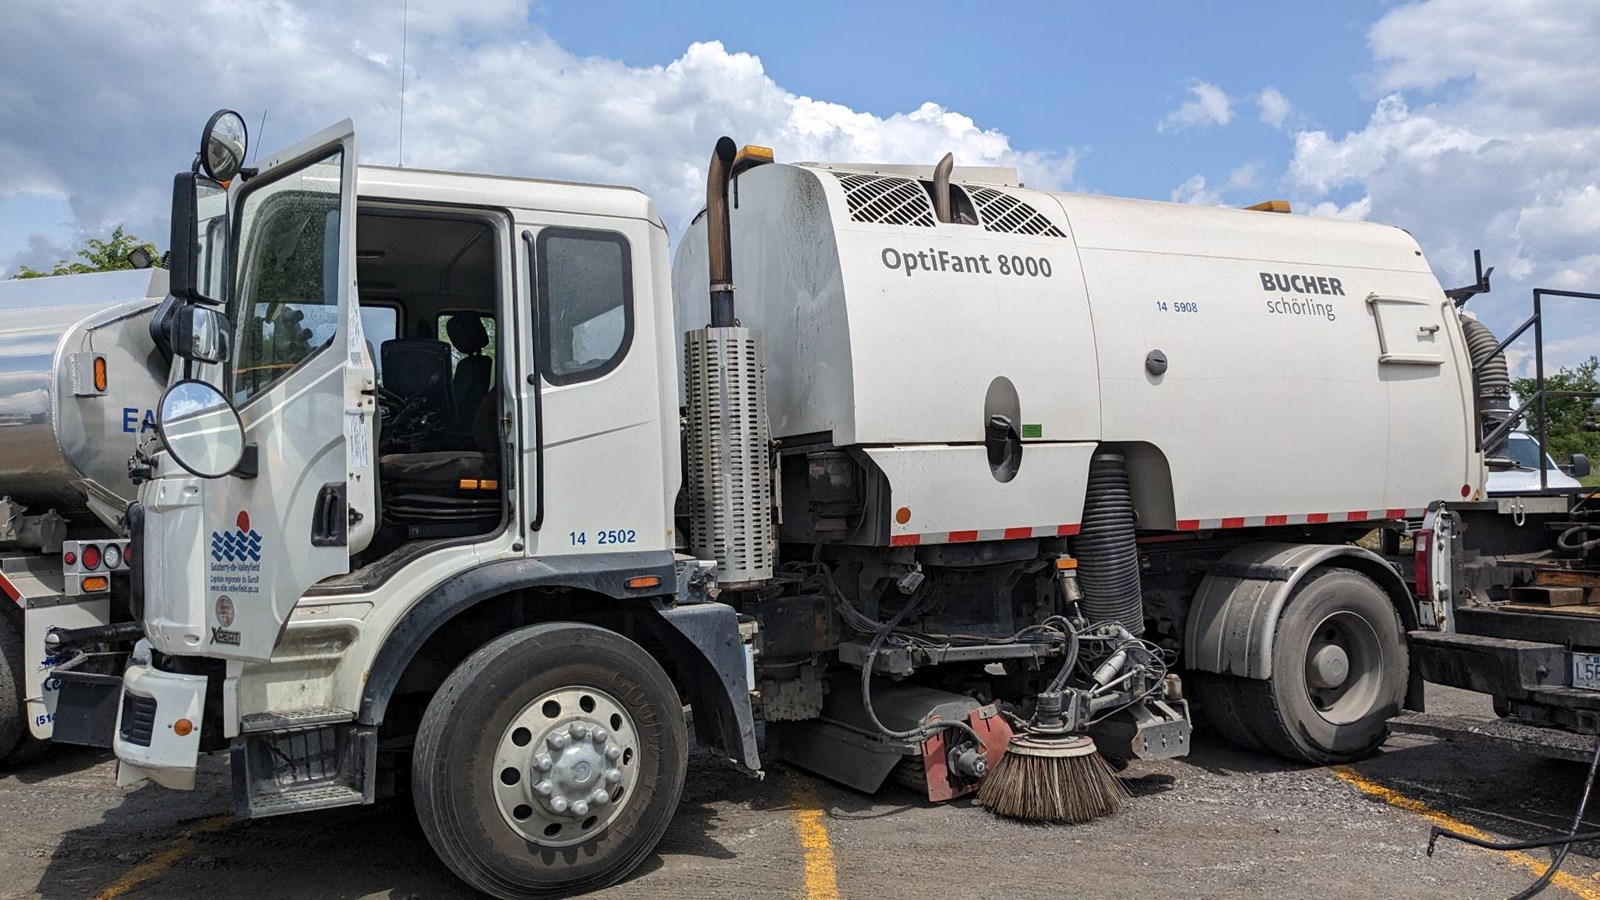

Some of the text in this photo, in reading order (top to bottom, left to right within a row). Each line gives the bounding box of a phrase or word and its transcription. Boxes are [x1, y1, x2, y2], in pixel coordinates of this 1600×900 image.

[881, 247, 1052, 278] OptiFant 8000
[1259, 272, 1346, 296] BUCHER
[1156, 301, 1198, 313] 14 5908
[1266, 297, 1336, 322] schörling
[569, 529, 636, 546] 14 2502
[36, 714, 56, 727] (51
